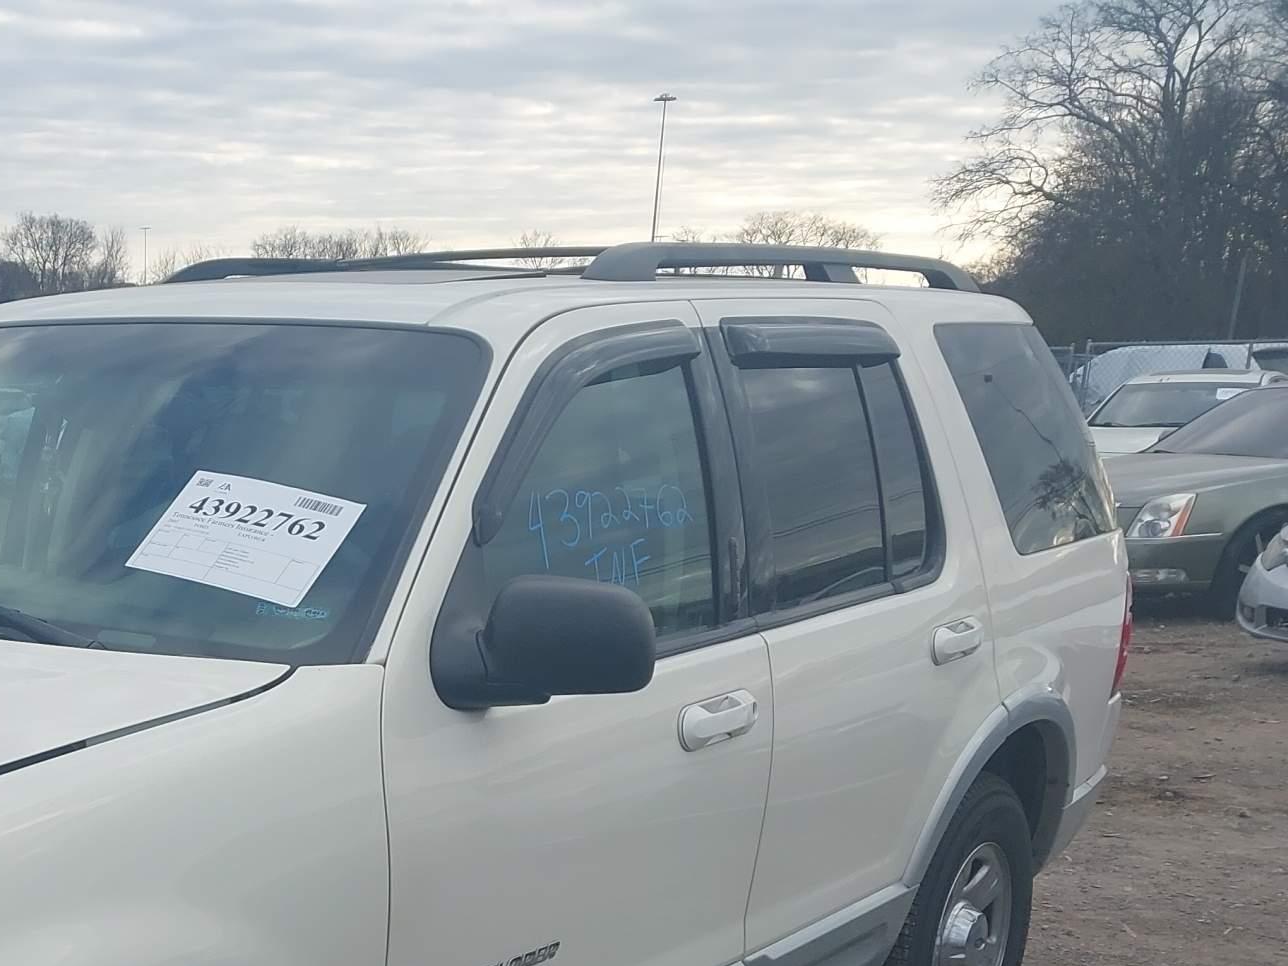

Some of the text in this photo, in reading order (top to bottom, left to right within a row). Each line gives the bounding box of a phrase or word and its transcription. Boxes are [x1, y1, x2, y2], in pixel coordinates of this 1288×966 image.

[188, 496, 326, 541] 43922762
[206, 517, 235, 530] Farmers
[234, 523, 270, 537] Insurance
[528, 484, 694, 569] 43922762
